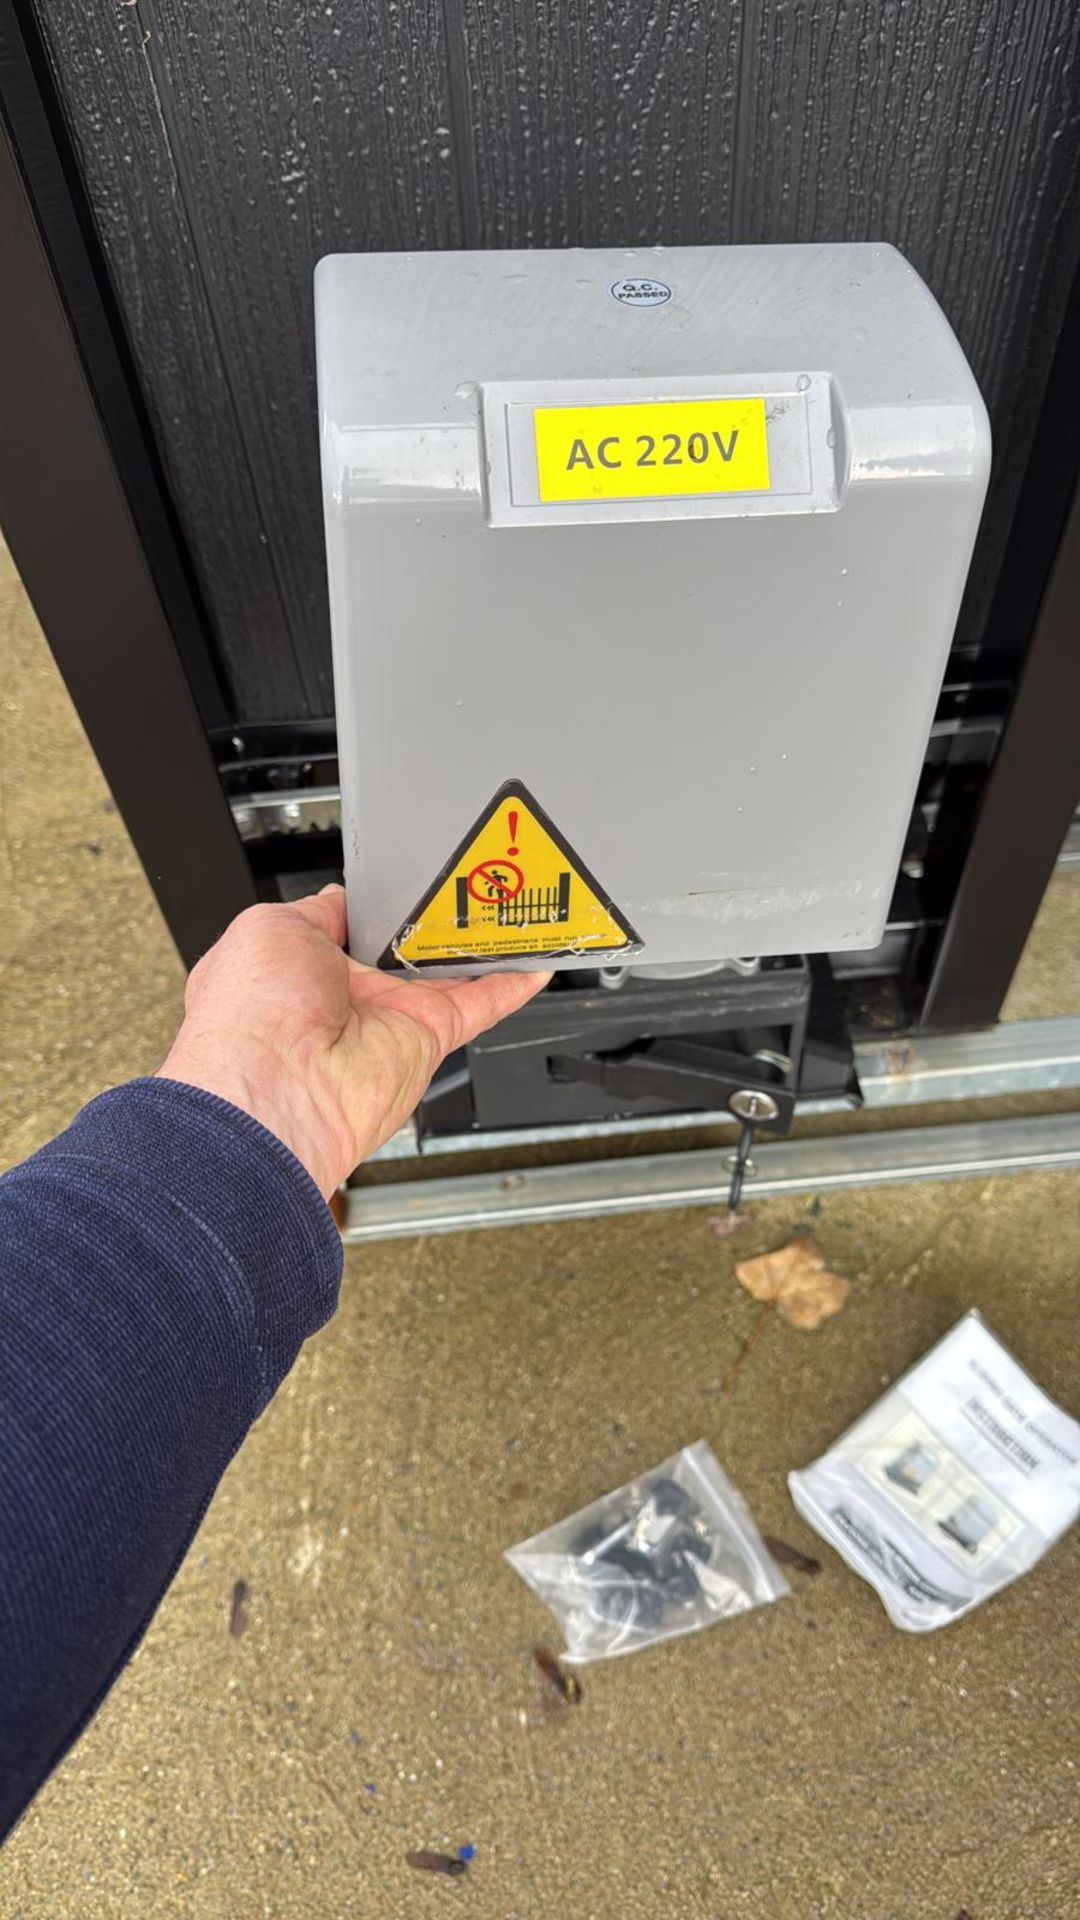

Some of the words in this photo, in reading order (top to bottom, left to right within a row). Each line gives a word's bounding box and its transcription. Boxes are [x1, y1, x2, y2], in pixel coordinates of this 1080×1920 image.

[622, 283, 658, 292] Q.C.
[618, 291, 668, 299] PASSED
[565, 436, 622, 471] AC
[636, 430, 739, 467] 220V
[493, 938, 538, 947] pedestrians
[496, 944, 528, 953] produce
